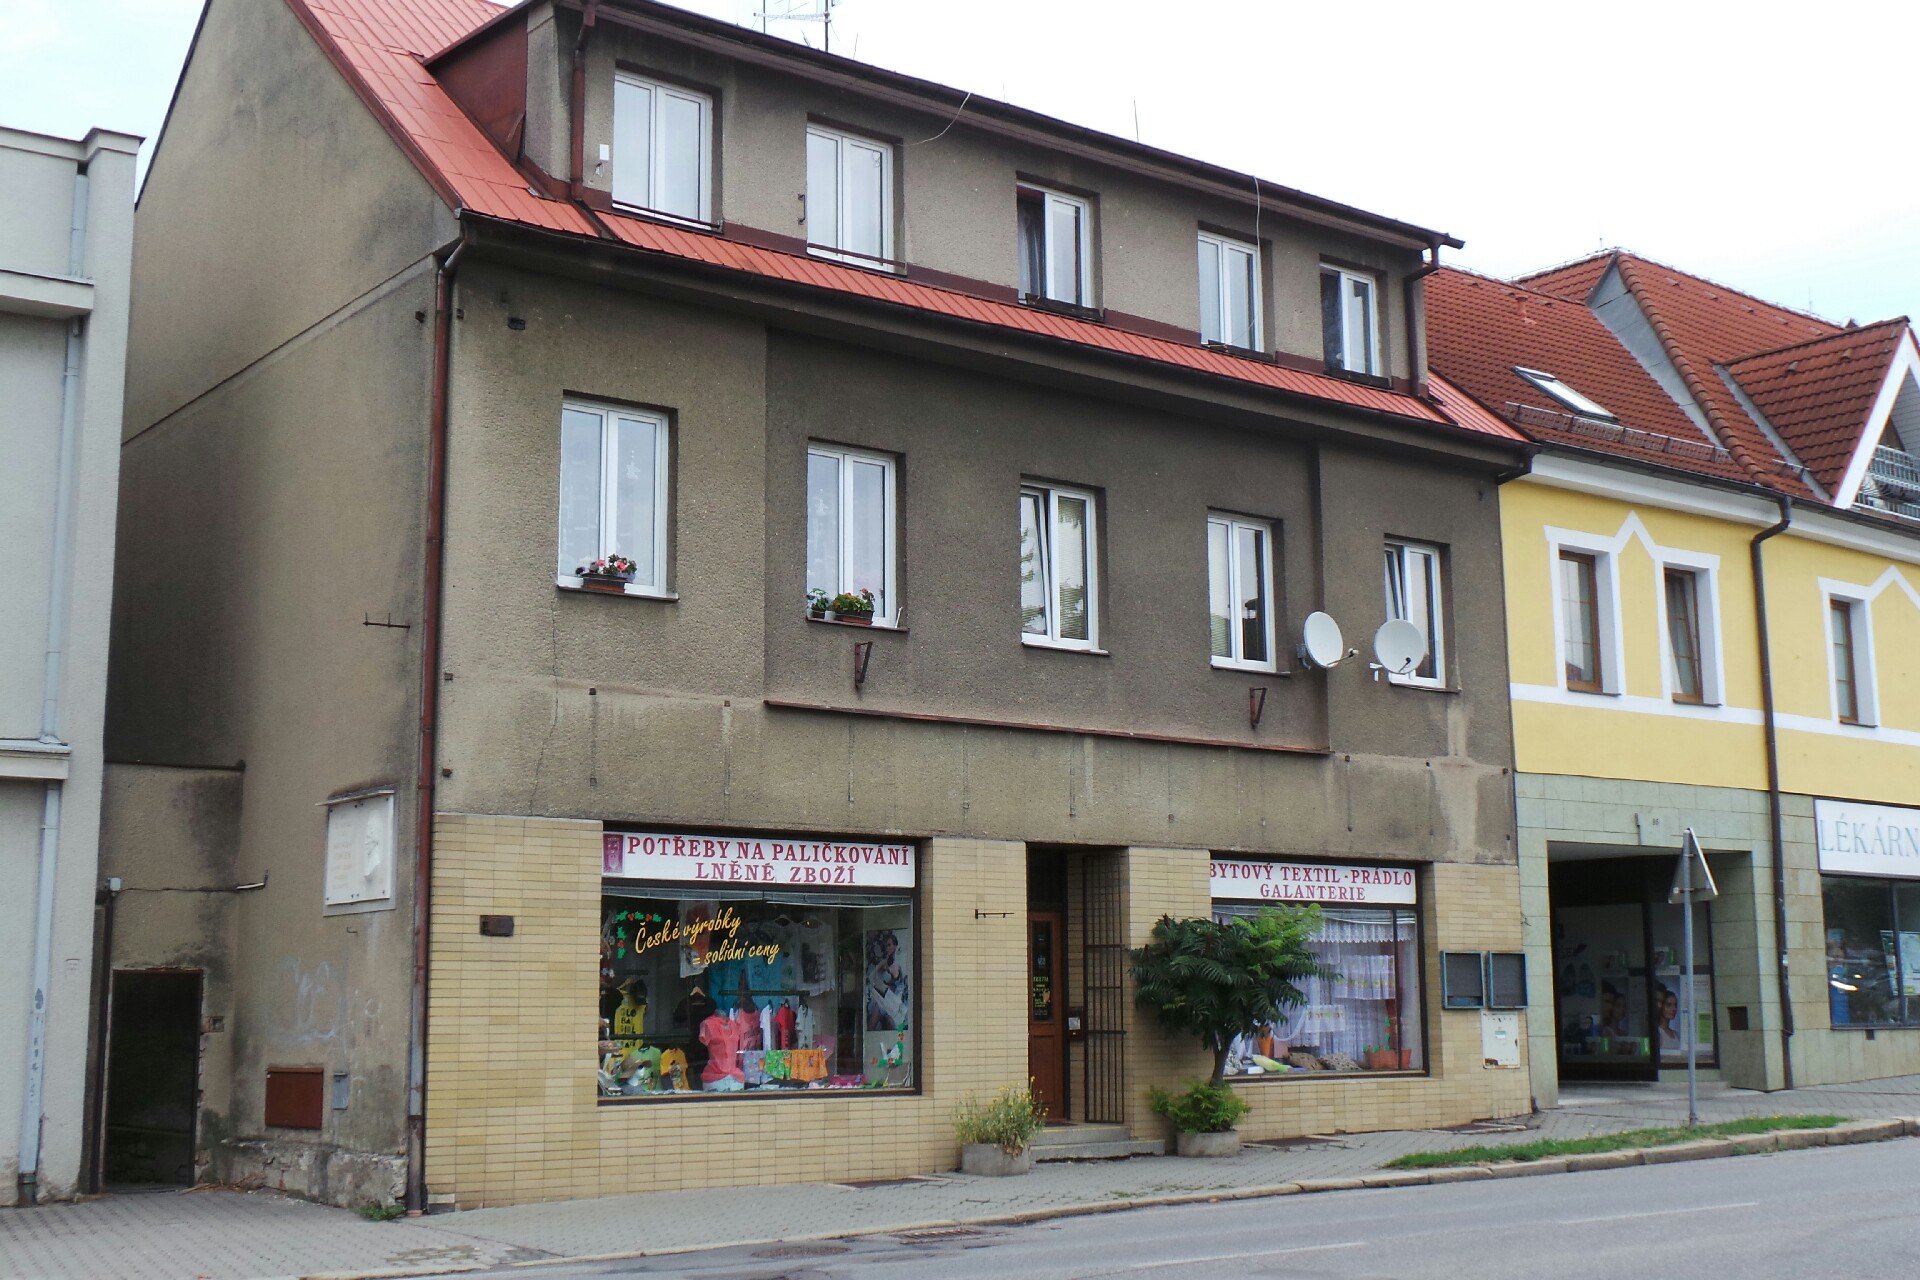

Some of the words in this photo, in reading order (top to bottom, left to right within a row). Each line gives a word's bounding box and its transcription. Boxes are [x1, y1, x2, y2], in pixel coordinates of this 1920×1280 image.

[627, 836, 730, 859] POTŘEBY
[737, 841, 766, 860] NA
[772, 842, 909, 865] PALIČKOVÁNÍ
[695, 860, 776, 881] LNĚNÉ
[790, 865, 856, 884] ZBOŽÍ
[1210, 862, 1274, 880] BYTOVÝ
[1260, 883, 1366, 900] GALANTERIE
[635, 919, 680, 954] České
[683, 906, 742, 945] výrobky
[704, 938, 749, 965] solidní
[748, 943, 780, 965] ceny
